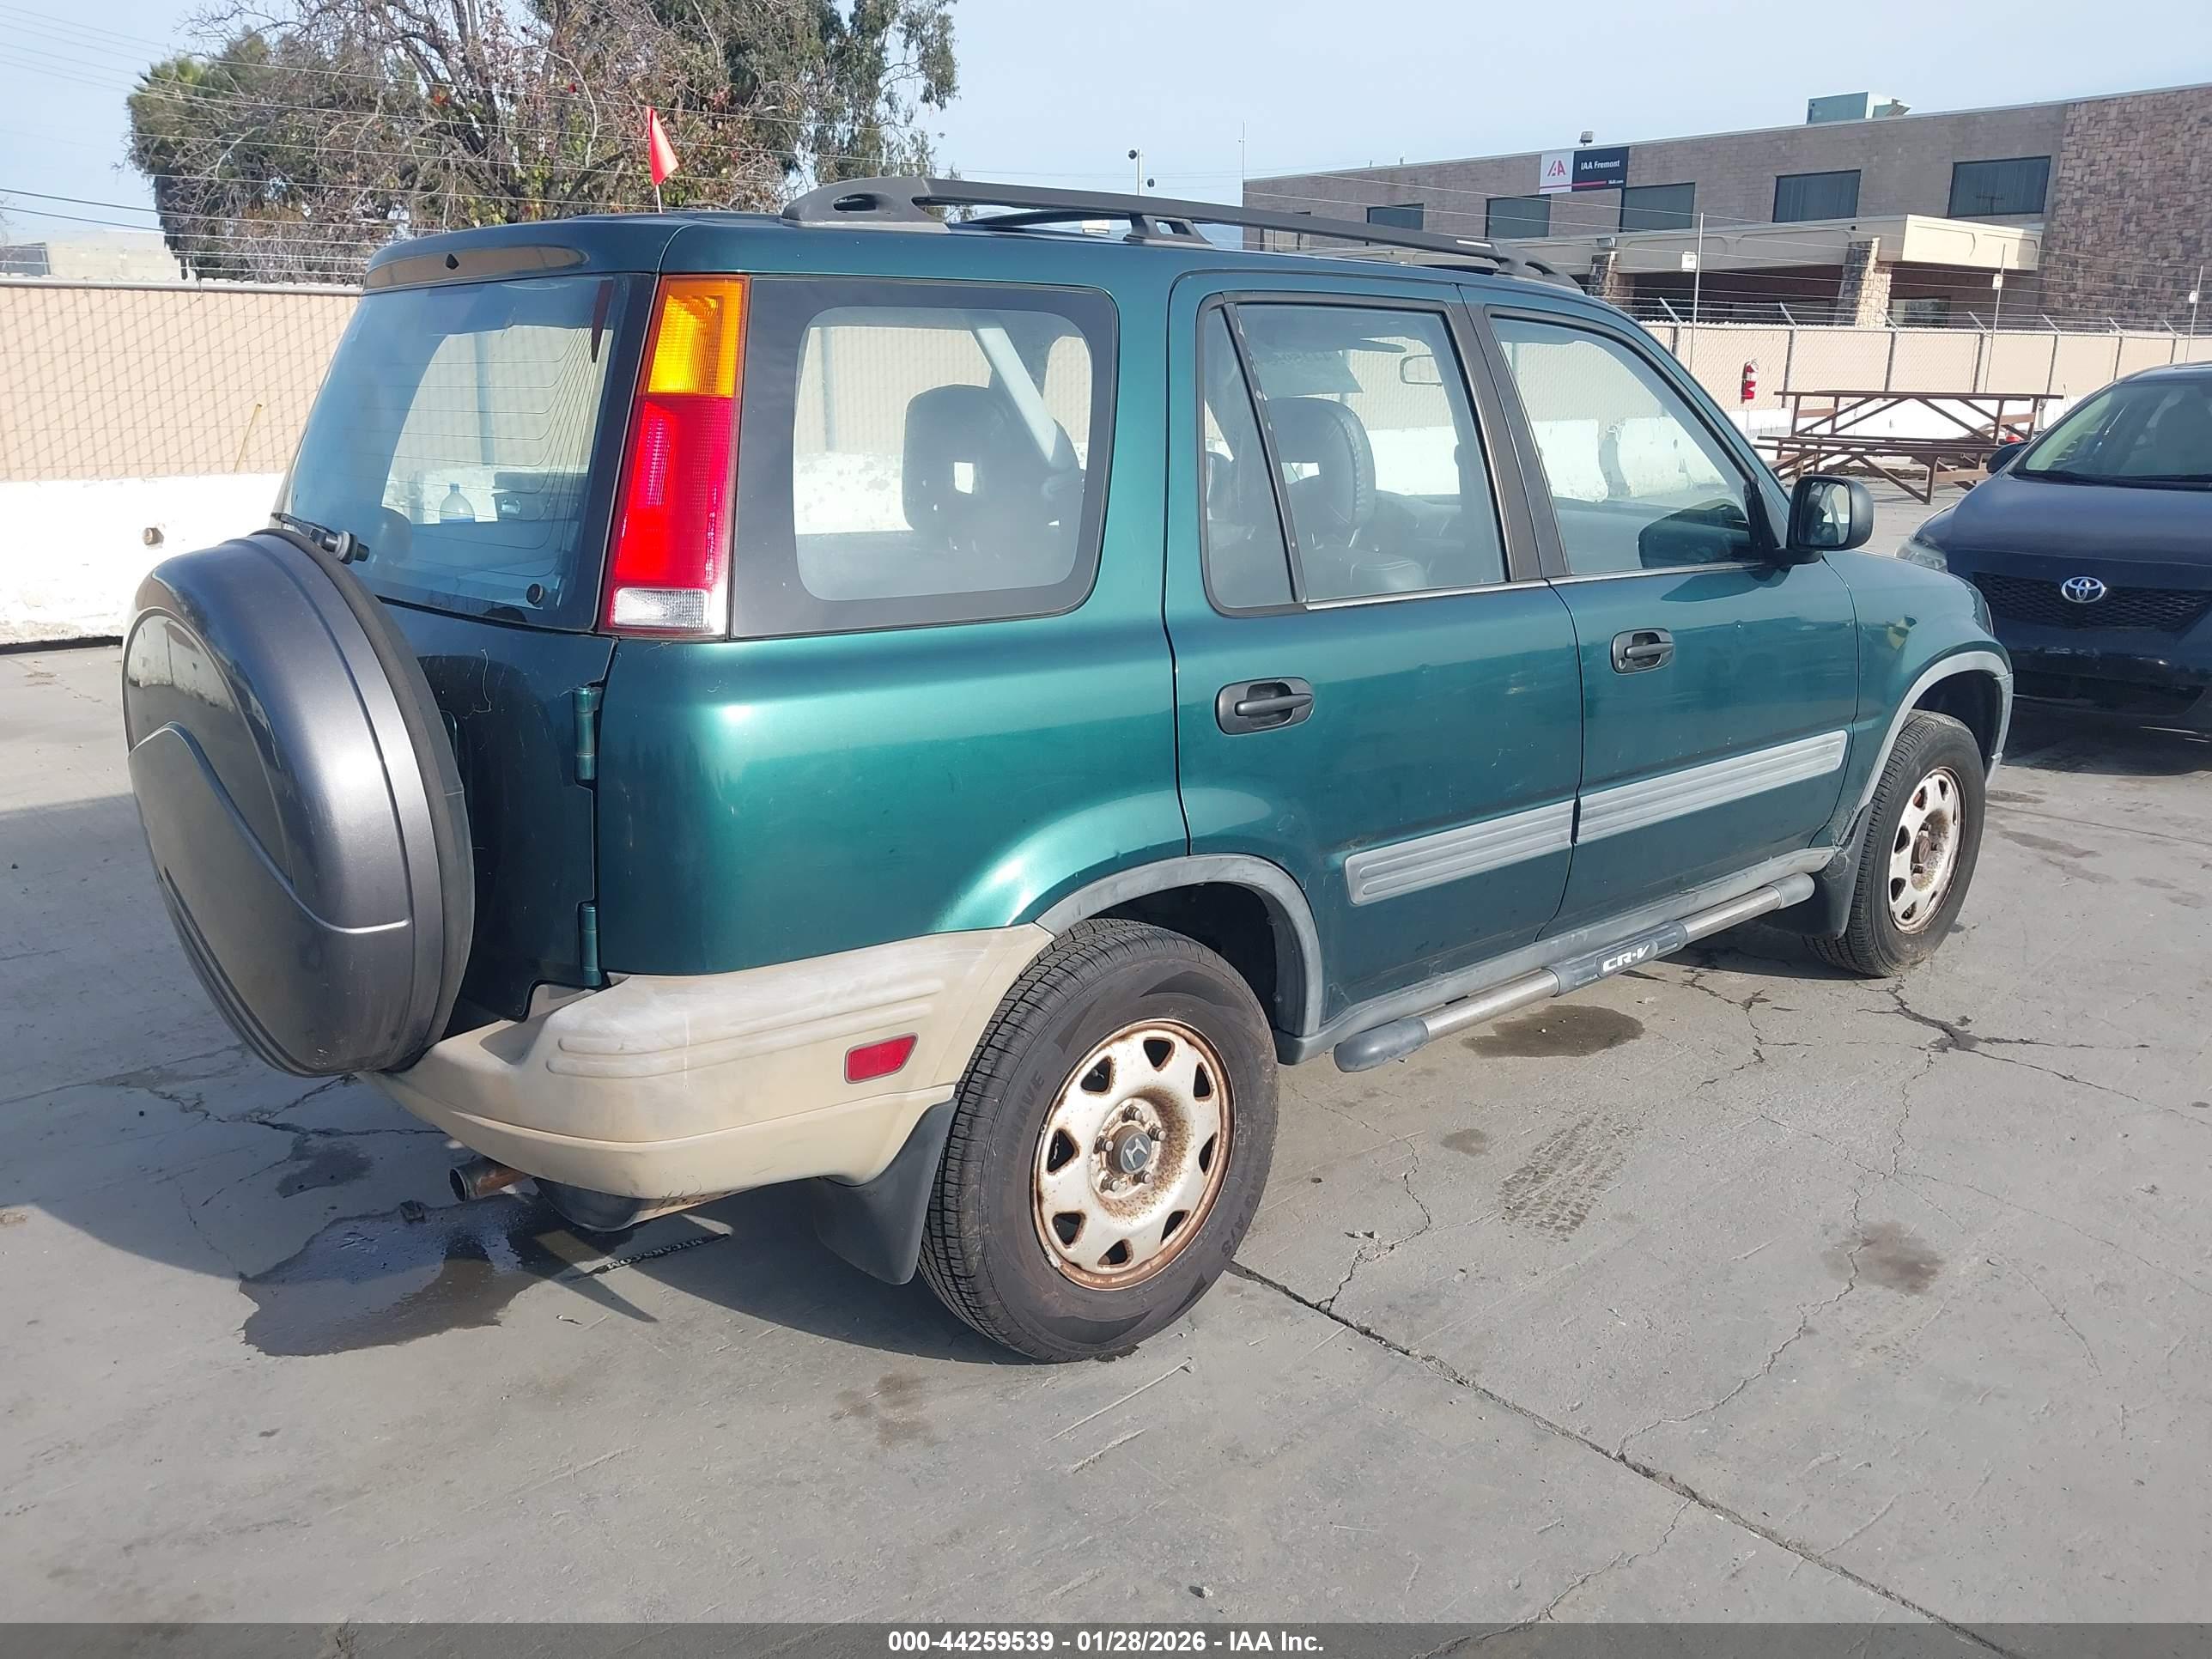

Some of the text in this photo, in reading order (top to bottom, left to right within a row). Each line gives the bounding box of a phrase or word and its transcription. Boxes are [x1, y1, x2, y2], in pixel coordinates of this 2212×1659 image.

[1581, 160, 1620, 170] IAA Fremont
[1603, 945, 1650, 972] CR-V
